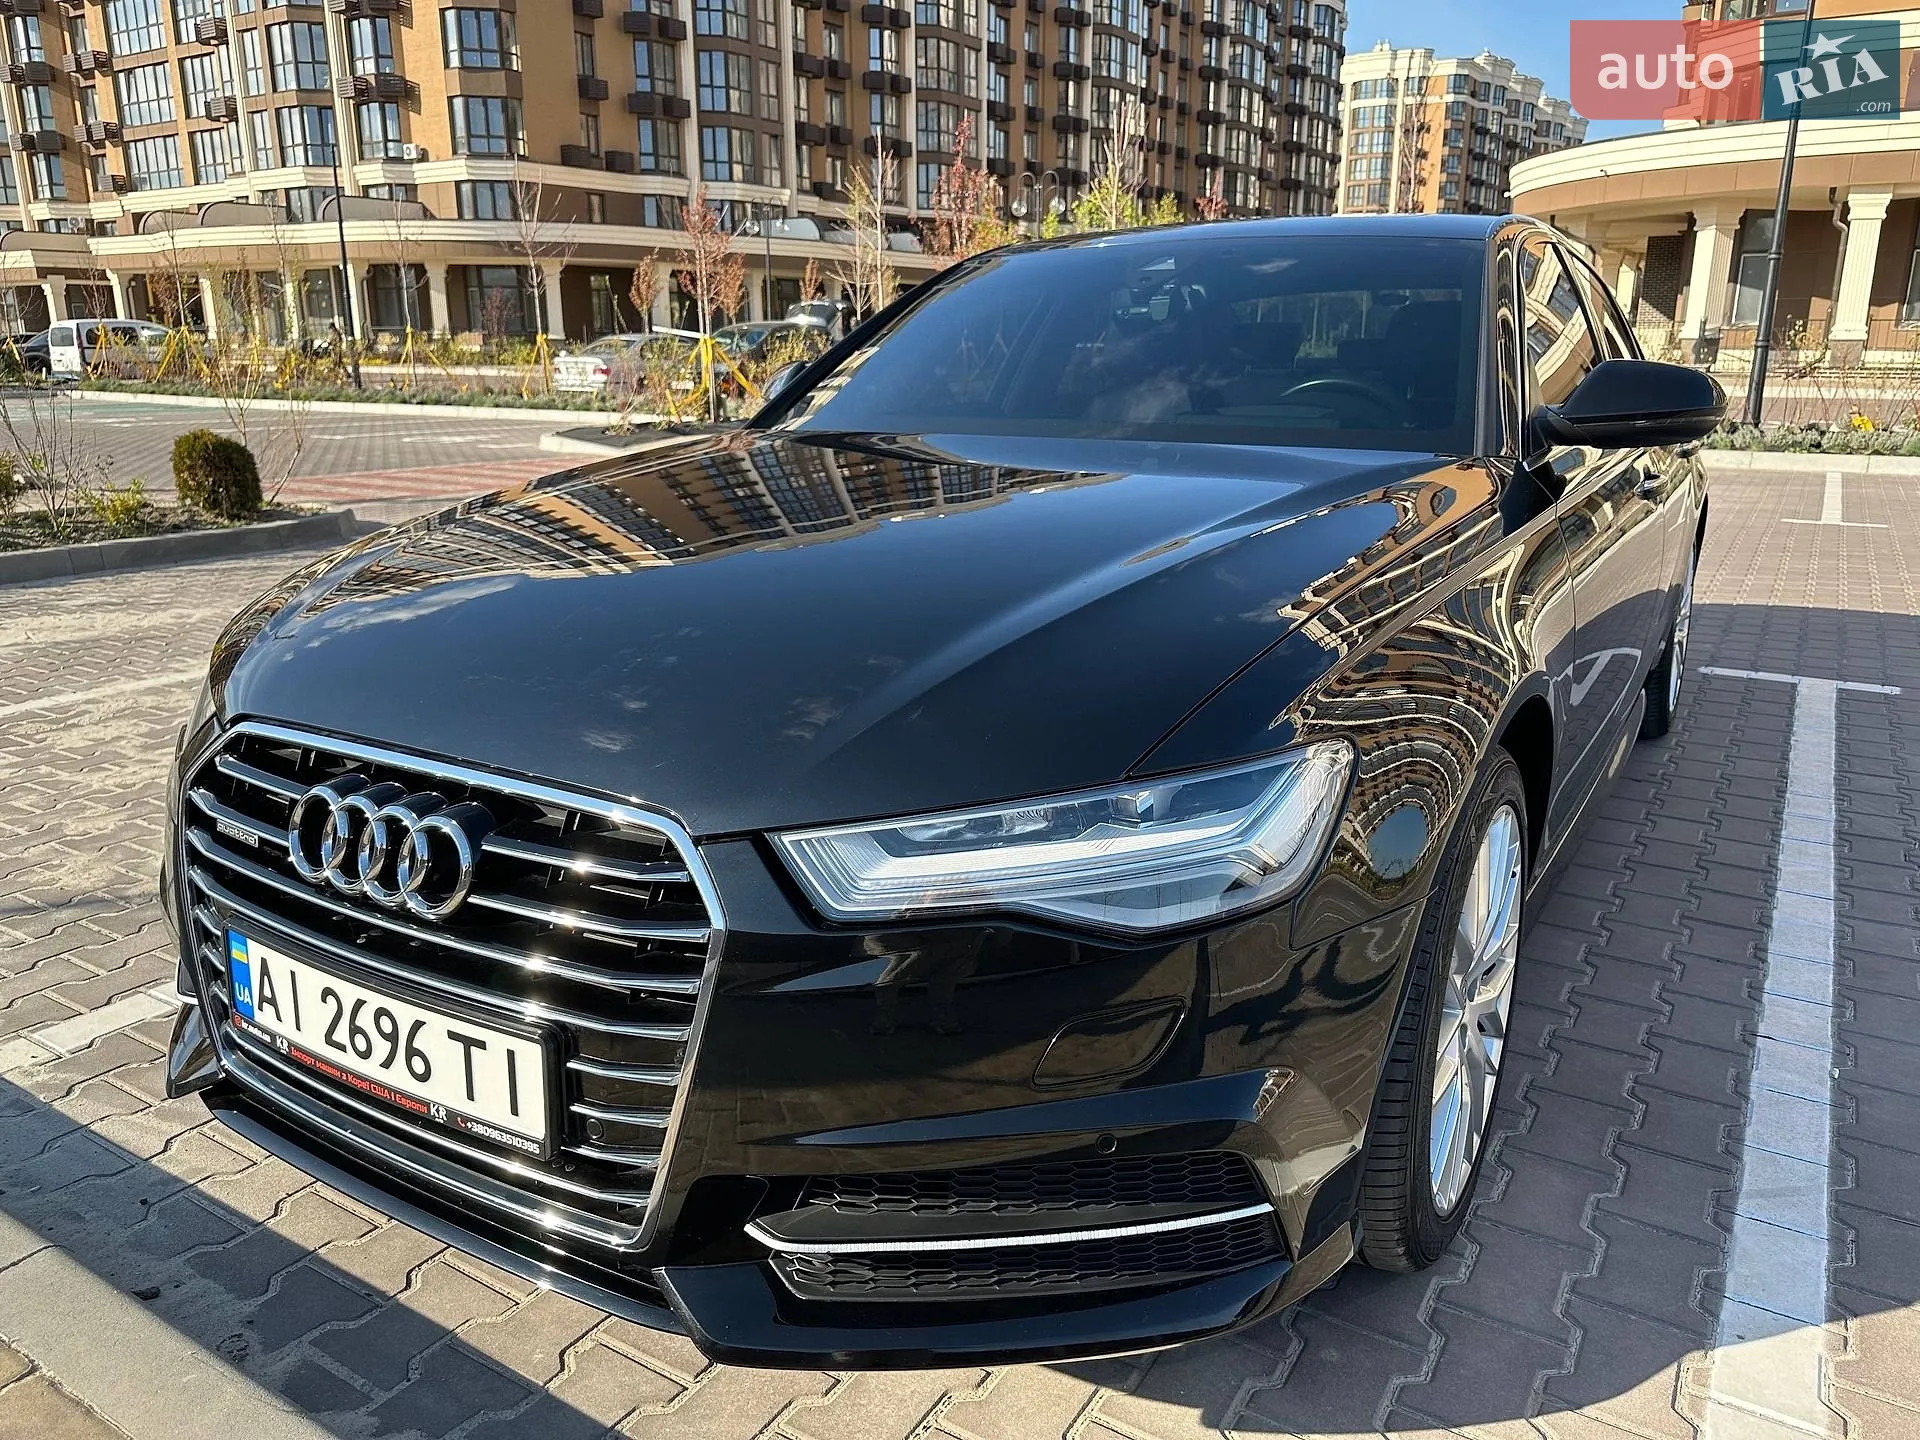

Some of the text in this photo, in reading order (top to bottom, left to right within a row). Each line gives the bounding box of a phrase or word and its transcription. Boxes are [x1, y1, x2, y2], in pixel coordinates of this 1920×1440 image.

[217, 823, 255, 845] quattro
[235, 982, 252, 1006] UA
[258, 957, 519, 1117] AI 2696 TI
[276, 1035, 289, 1052] KR
[370, 1083, 391, 1099] США
[430, 1102, 447, 1120] KR
